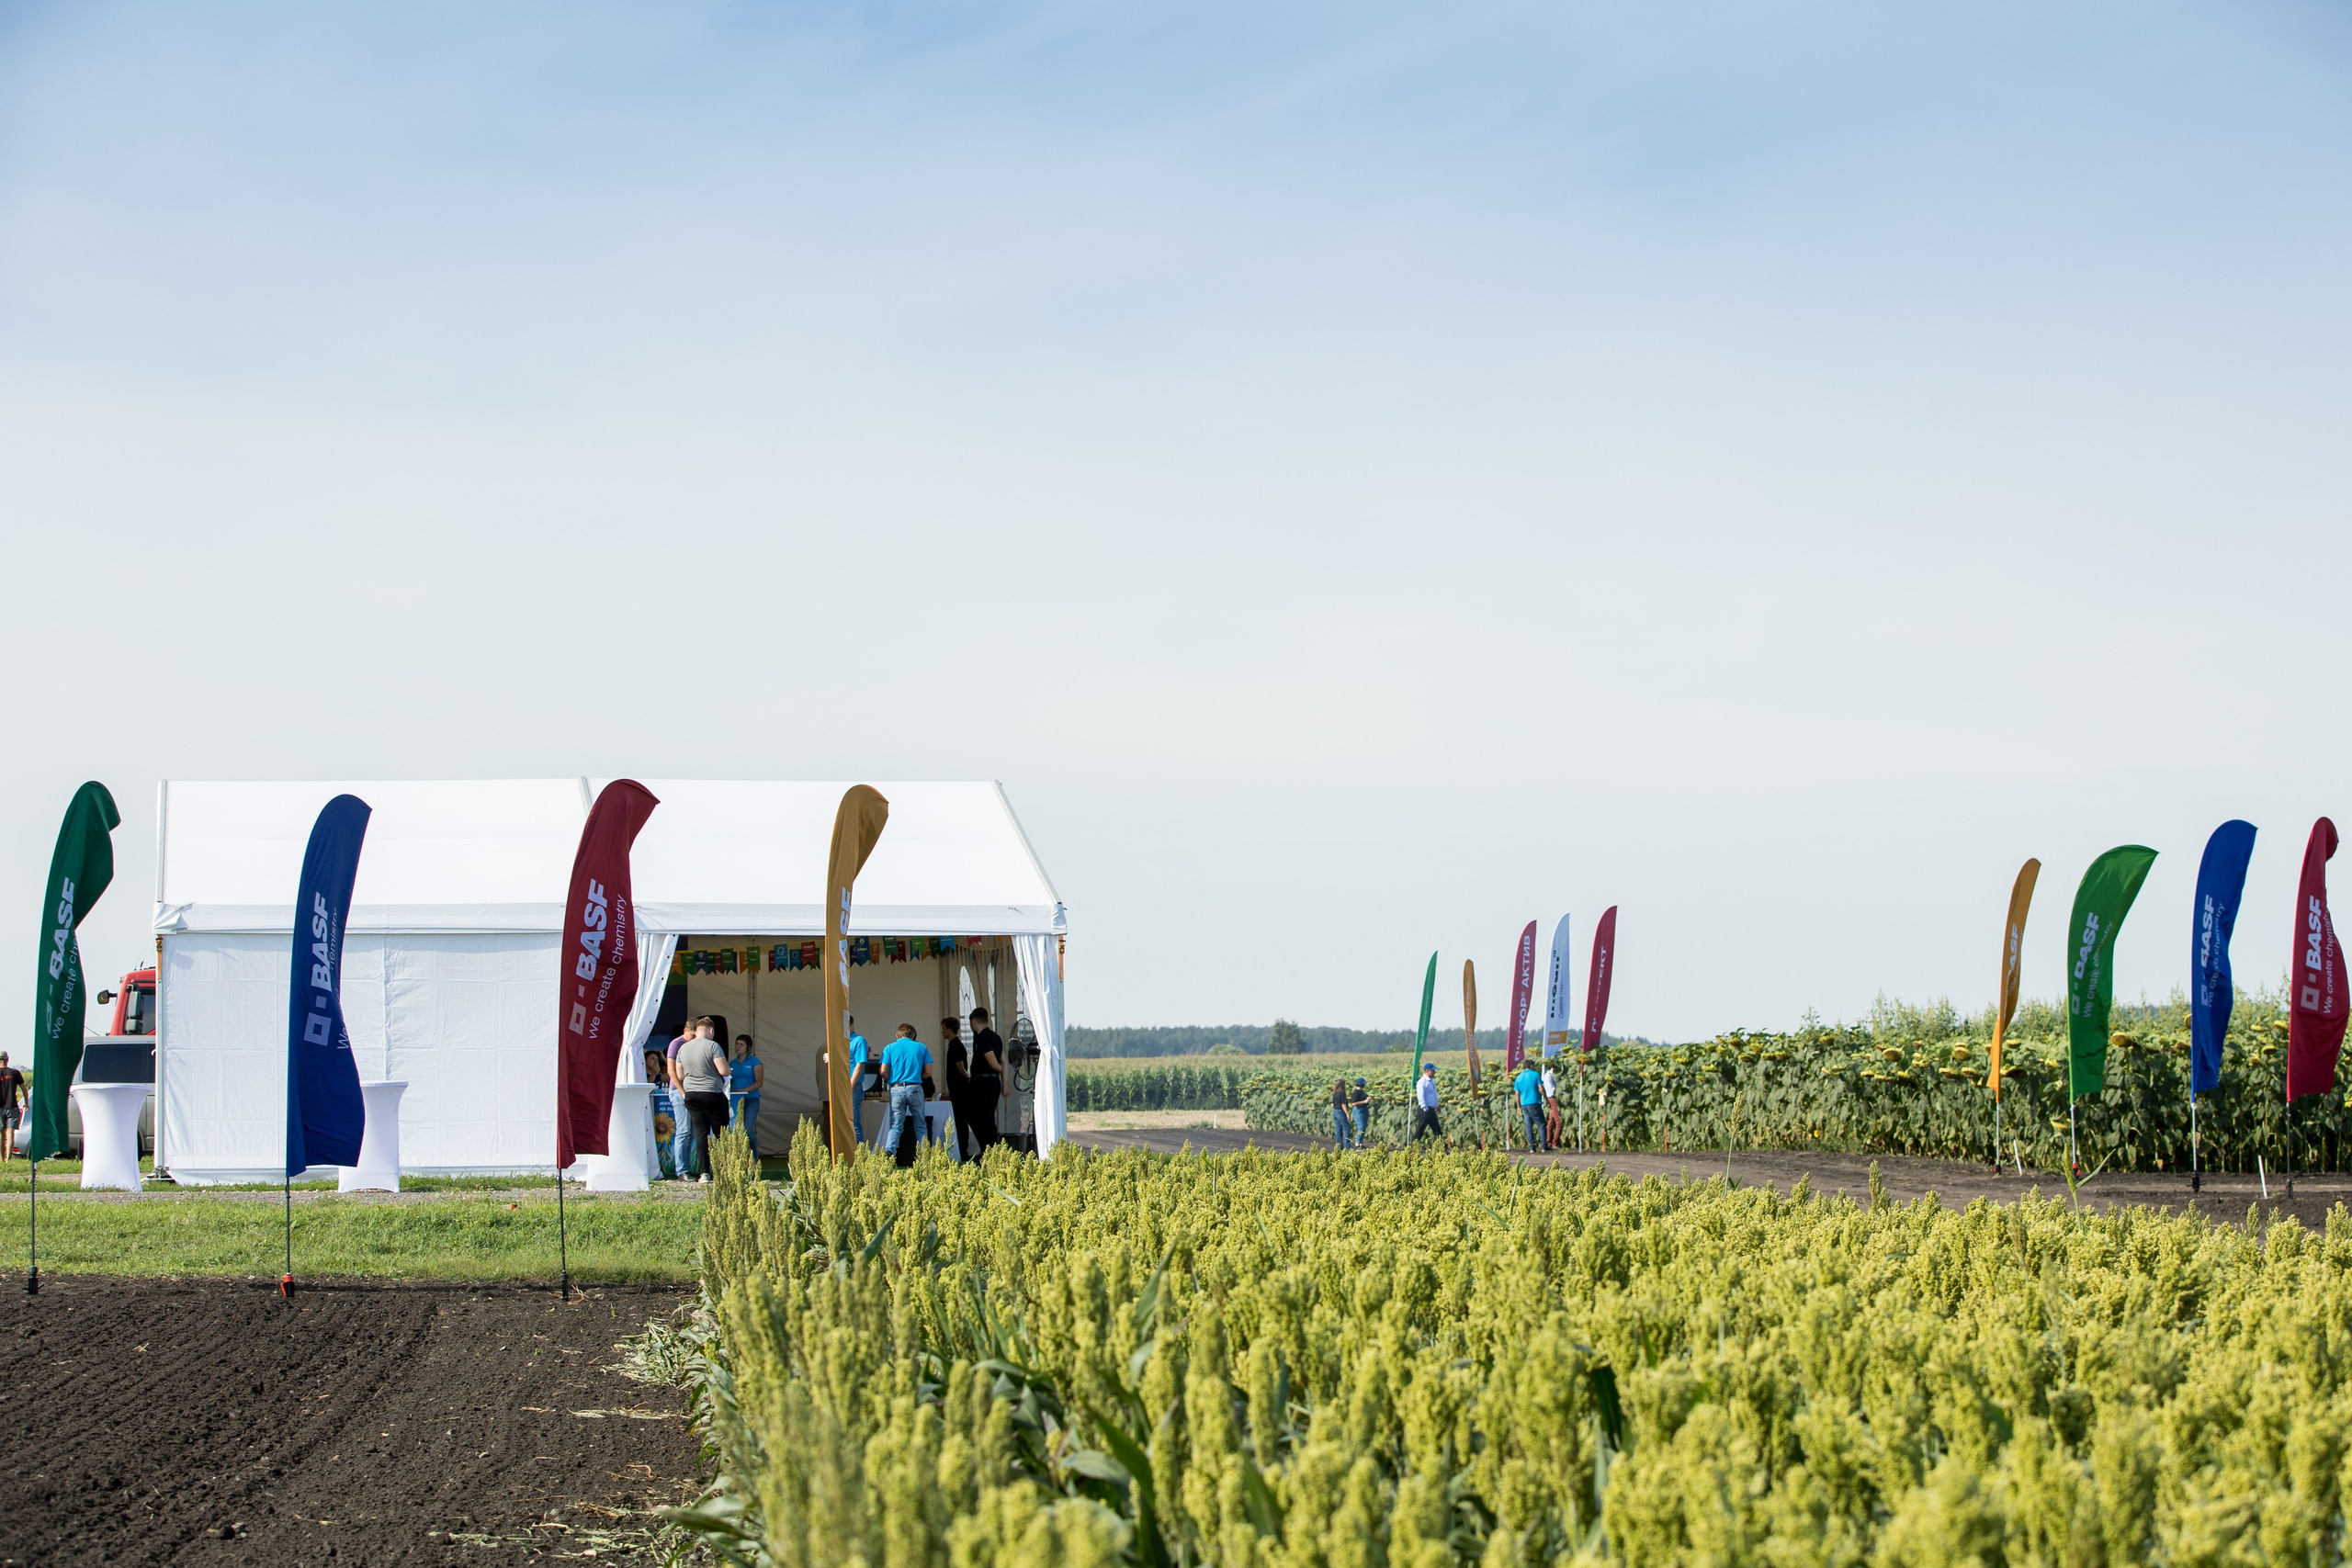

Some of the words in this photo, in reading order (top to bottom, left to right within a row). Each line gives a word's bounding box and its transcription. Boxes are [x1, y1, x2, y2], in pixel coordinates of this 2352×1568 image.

[49, 876, 75, 980] BASF
[311, 891, 333, 992] BASF
[330, 907, 338, 970] emistry
[575, 878, 608, 981] BASF
[612, 894, 628, 964] chemistry
[839, 886, 852, 988] BASF
[2008, 923, 2018, 975] ASF
[2074, 912, 2100, 979] BASF
[2092, 920, 2113, 967] chemistry
[2200, 894, 2214, 968] BASF
[2214, 902, 2224, 955] chemistry
[2305, 895, 2322, 971] BASF
[594, 967, 616, 1012] create
[1521, 935, 1531, 988] АКТИВ
[2087, 969, 2099, 999] create
[52, 1017, 65, 1039] We
[61, 967, 76, 1013] create
[589, 1016, 601, 1039] We
[2083, 1001, 2093, 1018] We
[2324, 996, 2333, 1014] We
